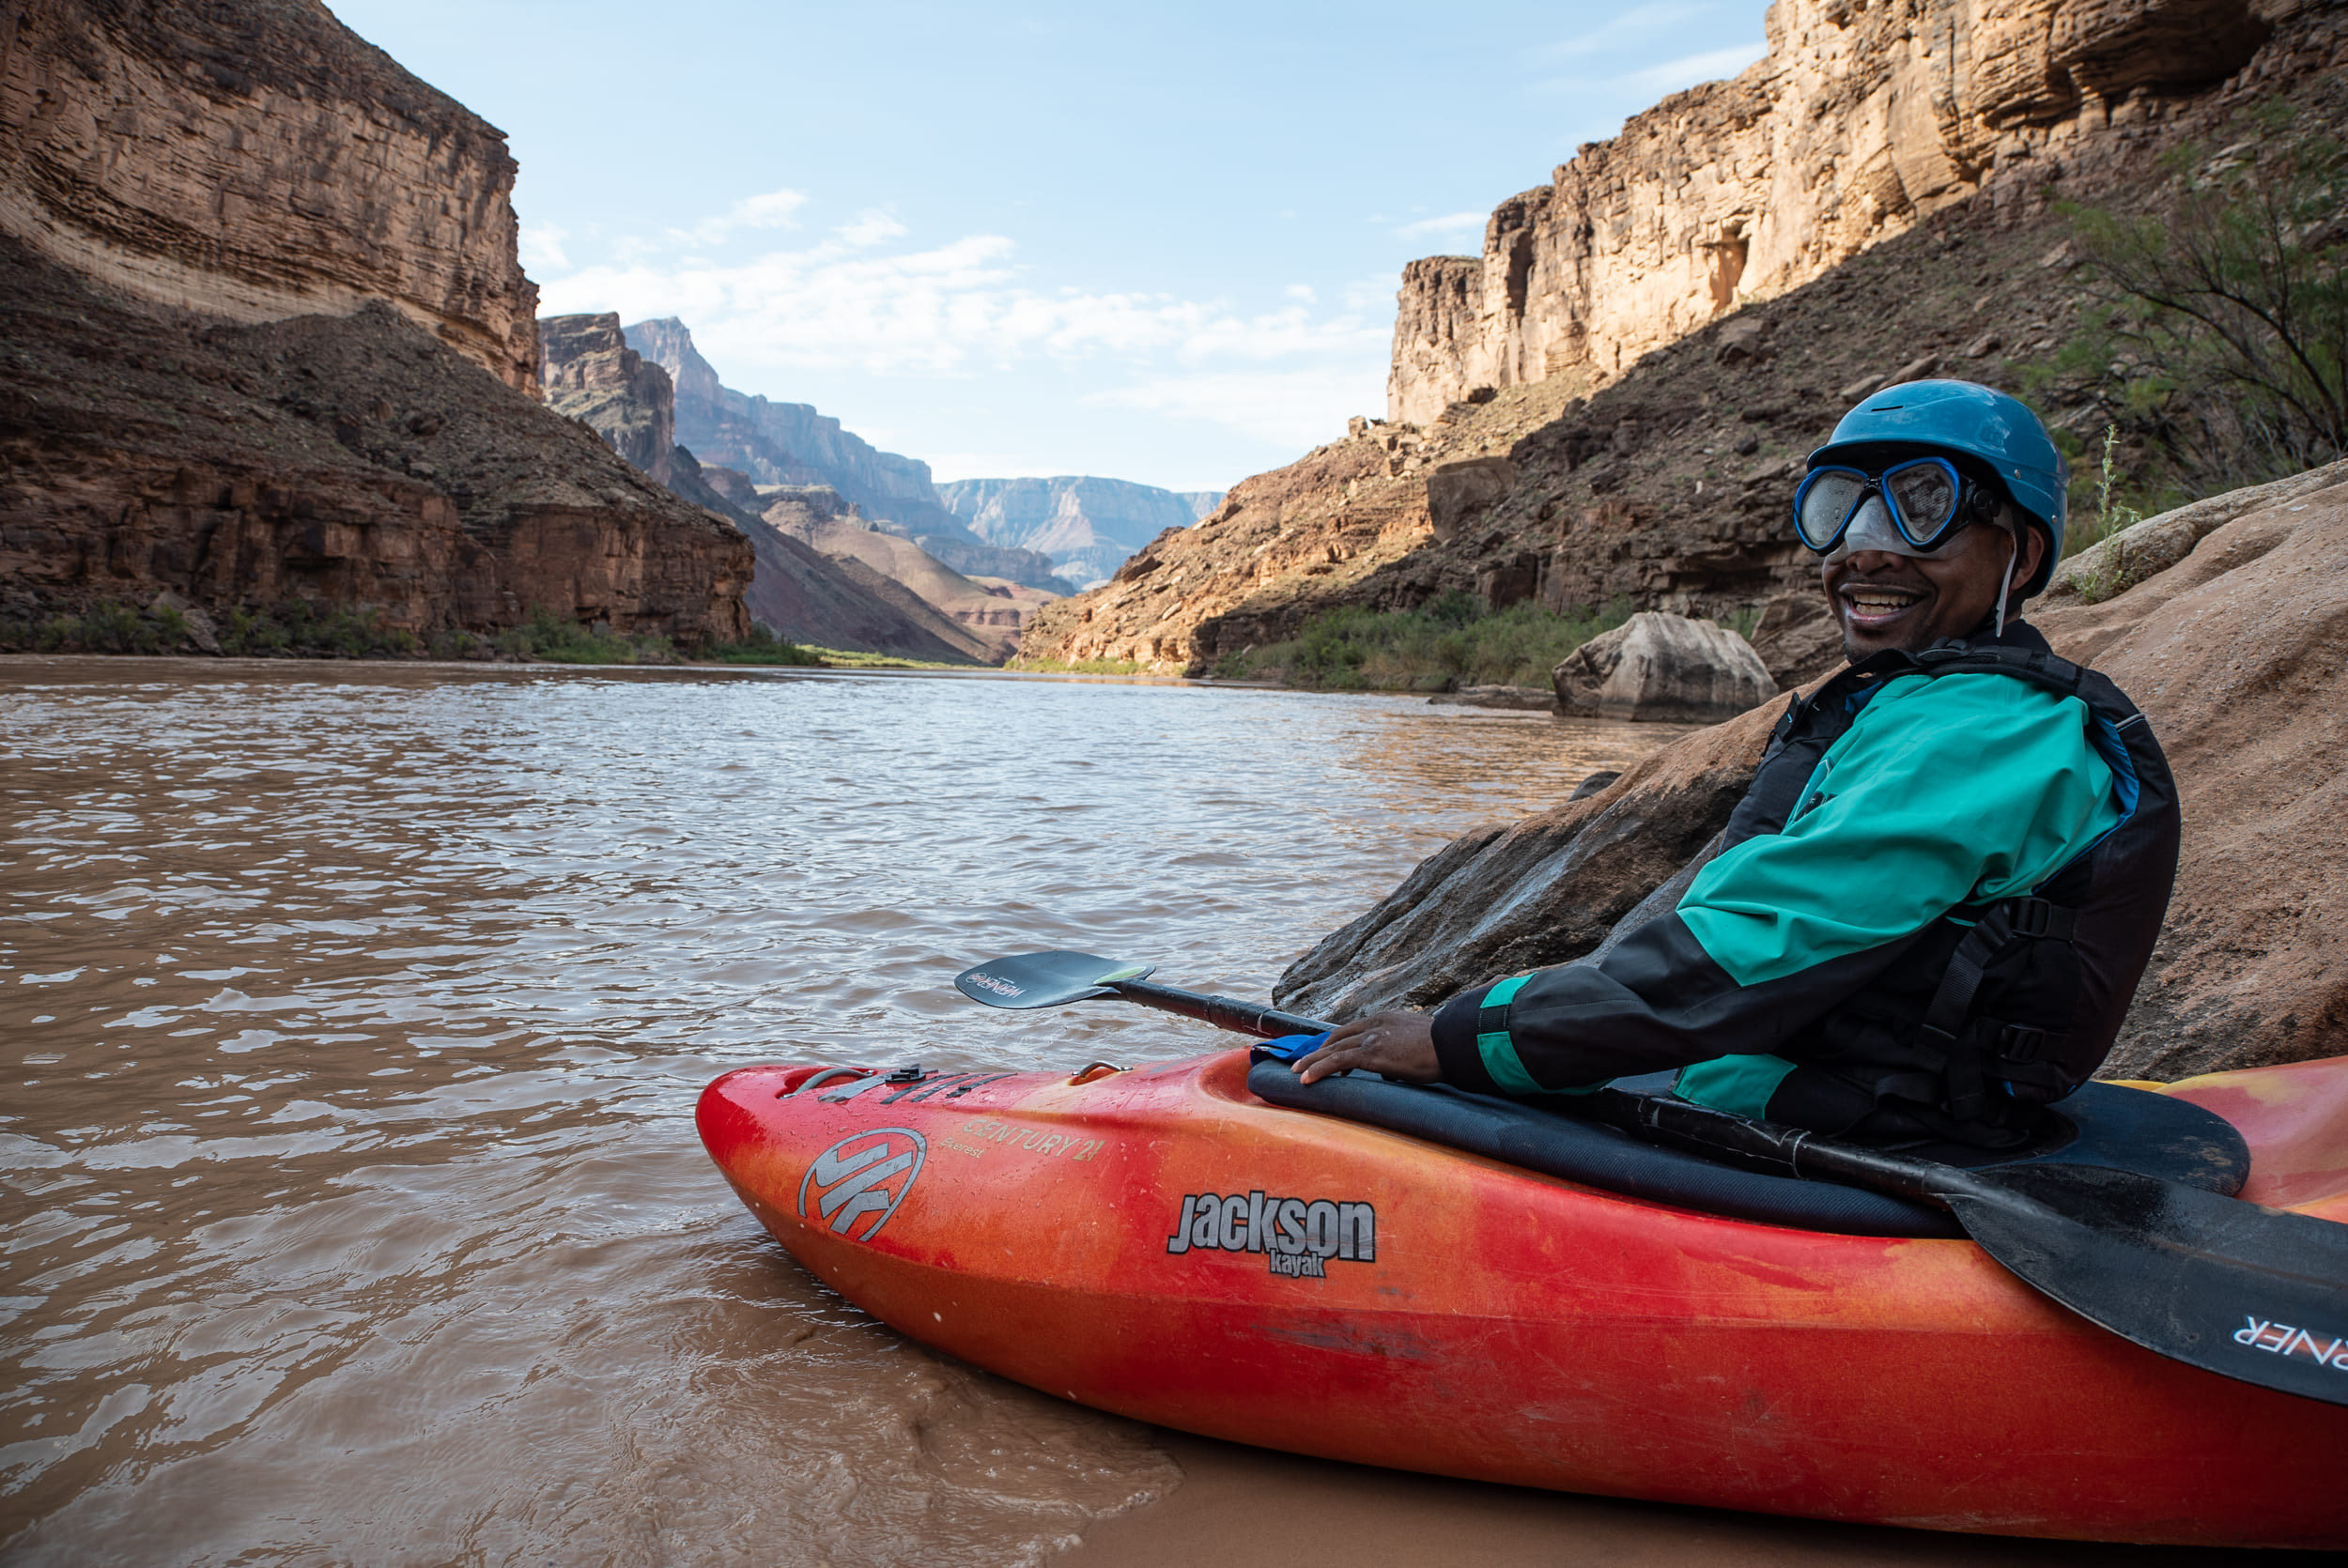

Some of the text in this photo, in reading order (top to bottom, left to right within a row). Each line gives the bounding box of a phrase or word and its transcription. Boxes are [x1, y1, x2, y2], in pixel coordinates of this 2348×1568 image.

[977, 977, 1027, 998] WERNER
[940, 1137, 985, 1159] Everest
[963, 1119, 1105, 1161] CENTURY 21
[1270, 1248, 1326, 1279] kayak
